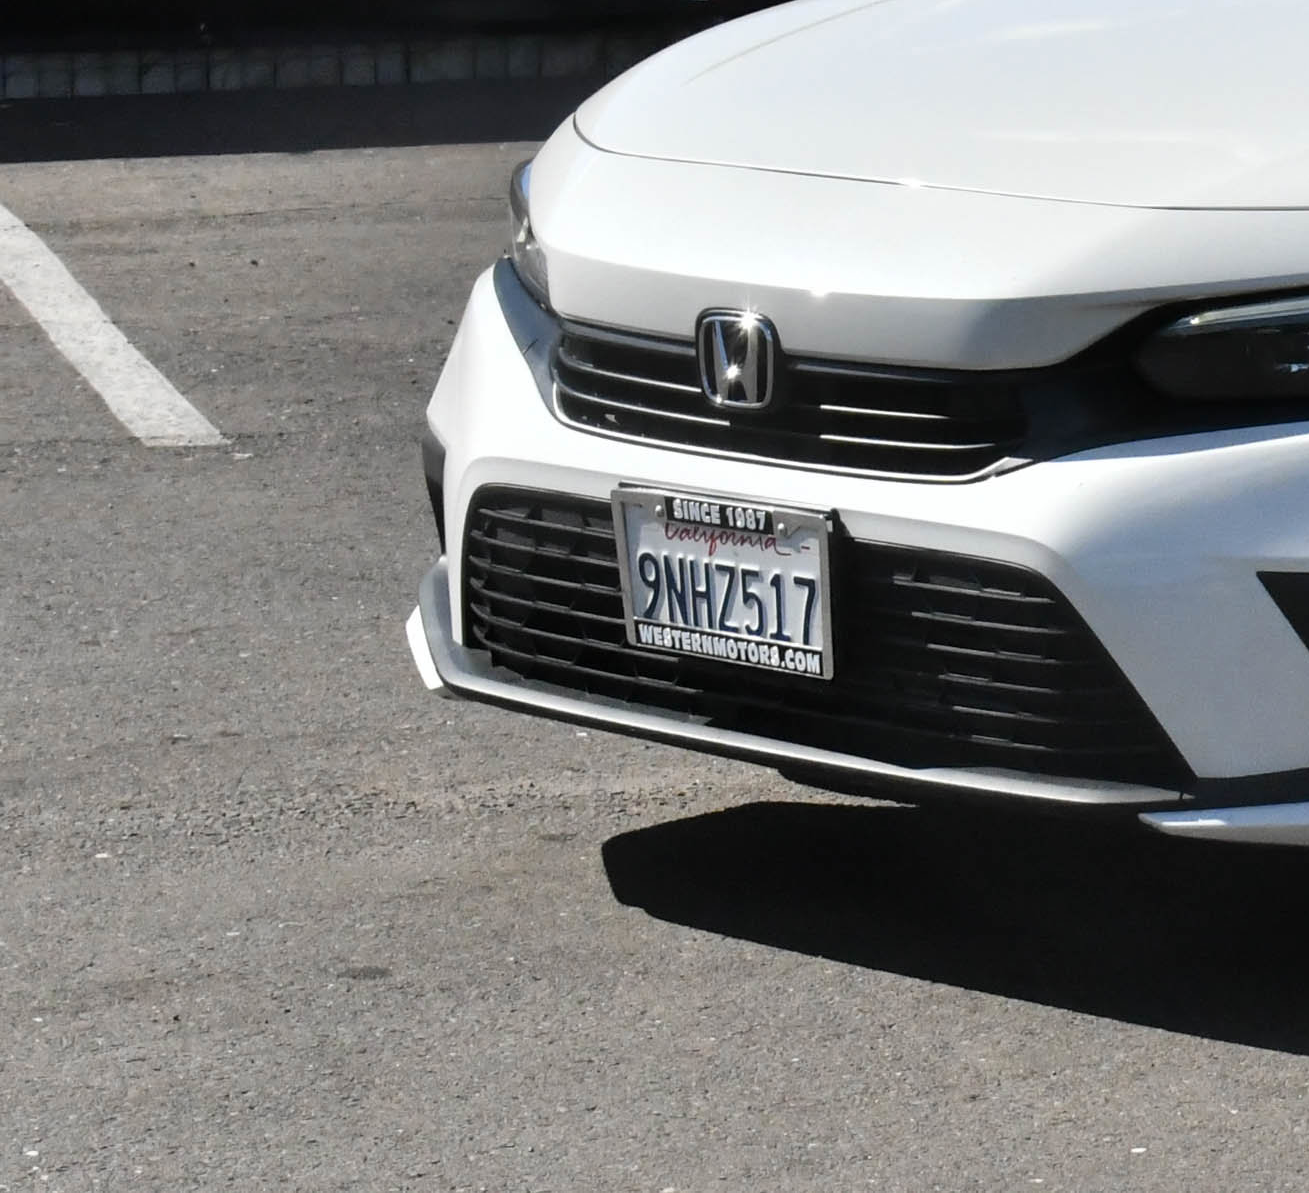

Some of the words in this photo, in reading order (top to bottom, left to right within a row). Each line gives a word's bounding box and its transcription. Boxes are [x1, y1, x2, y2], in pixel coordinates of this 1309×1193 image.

[672, 498, 720, 525] SINCE
[726, 506, 766, 531] 1987
[638, 552, 816, 646] 9NHZ517
[638, 622, 821, 675] WESTERNMOTORS.COM
